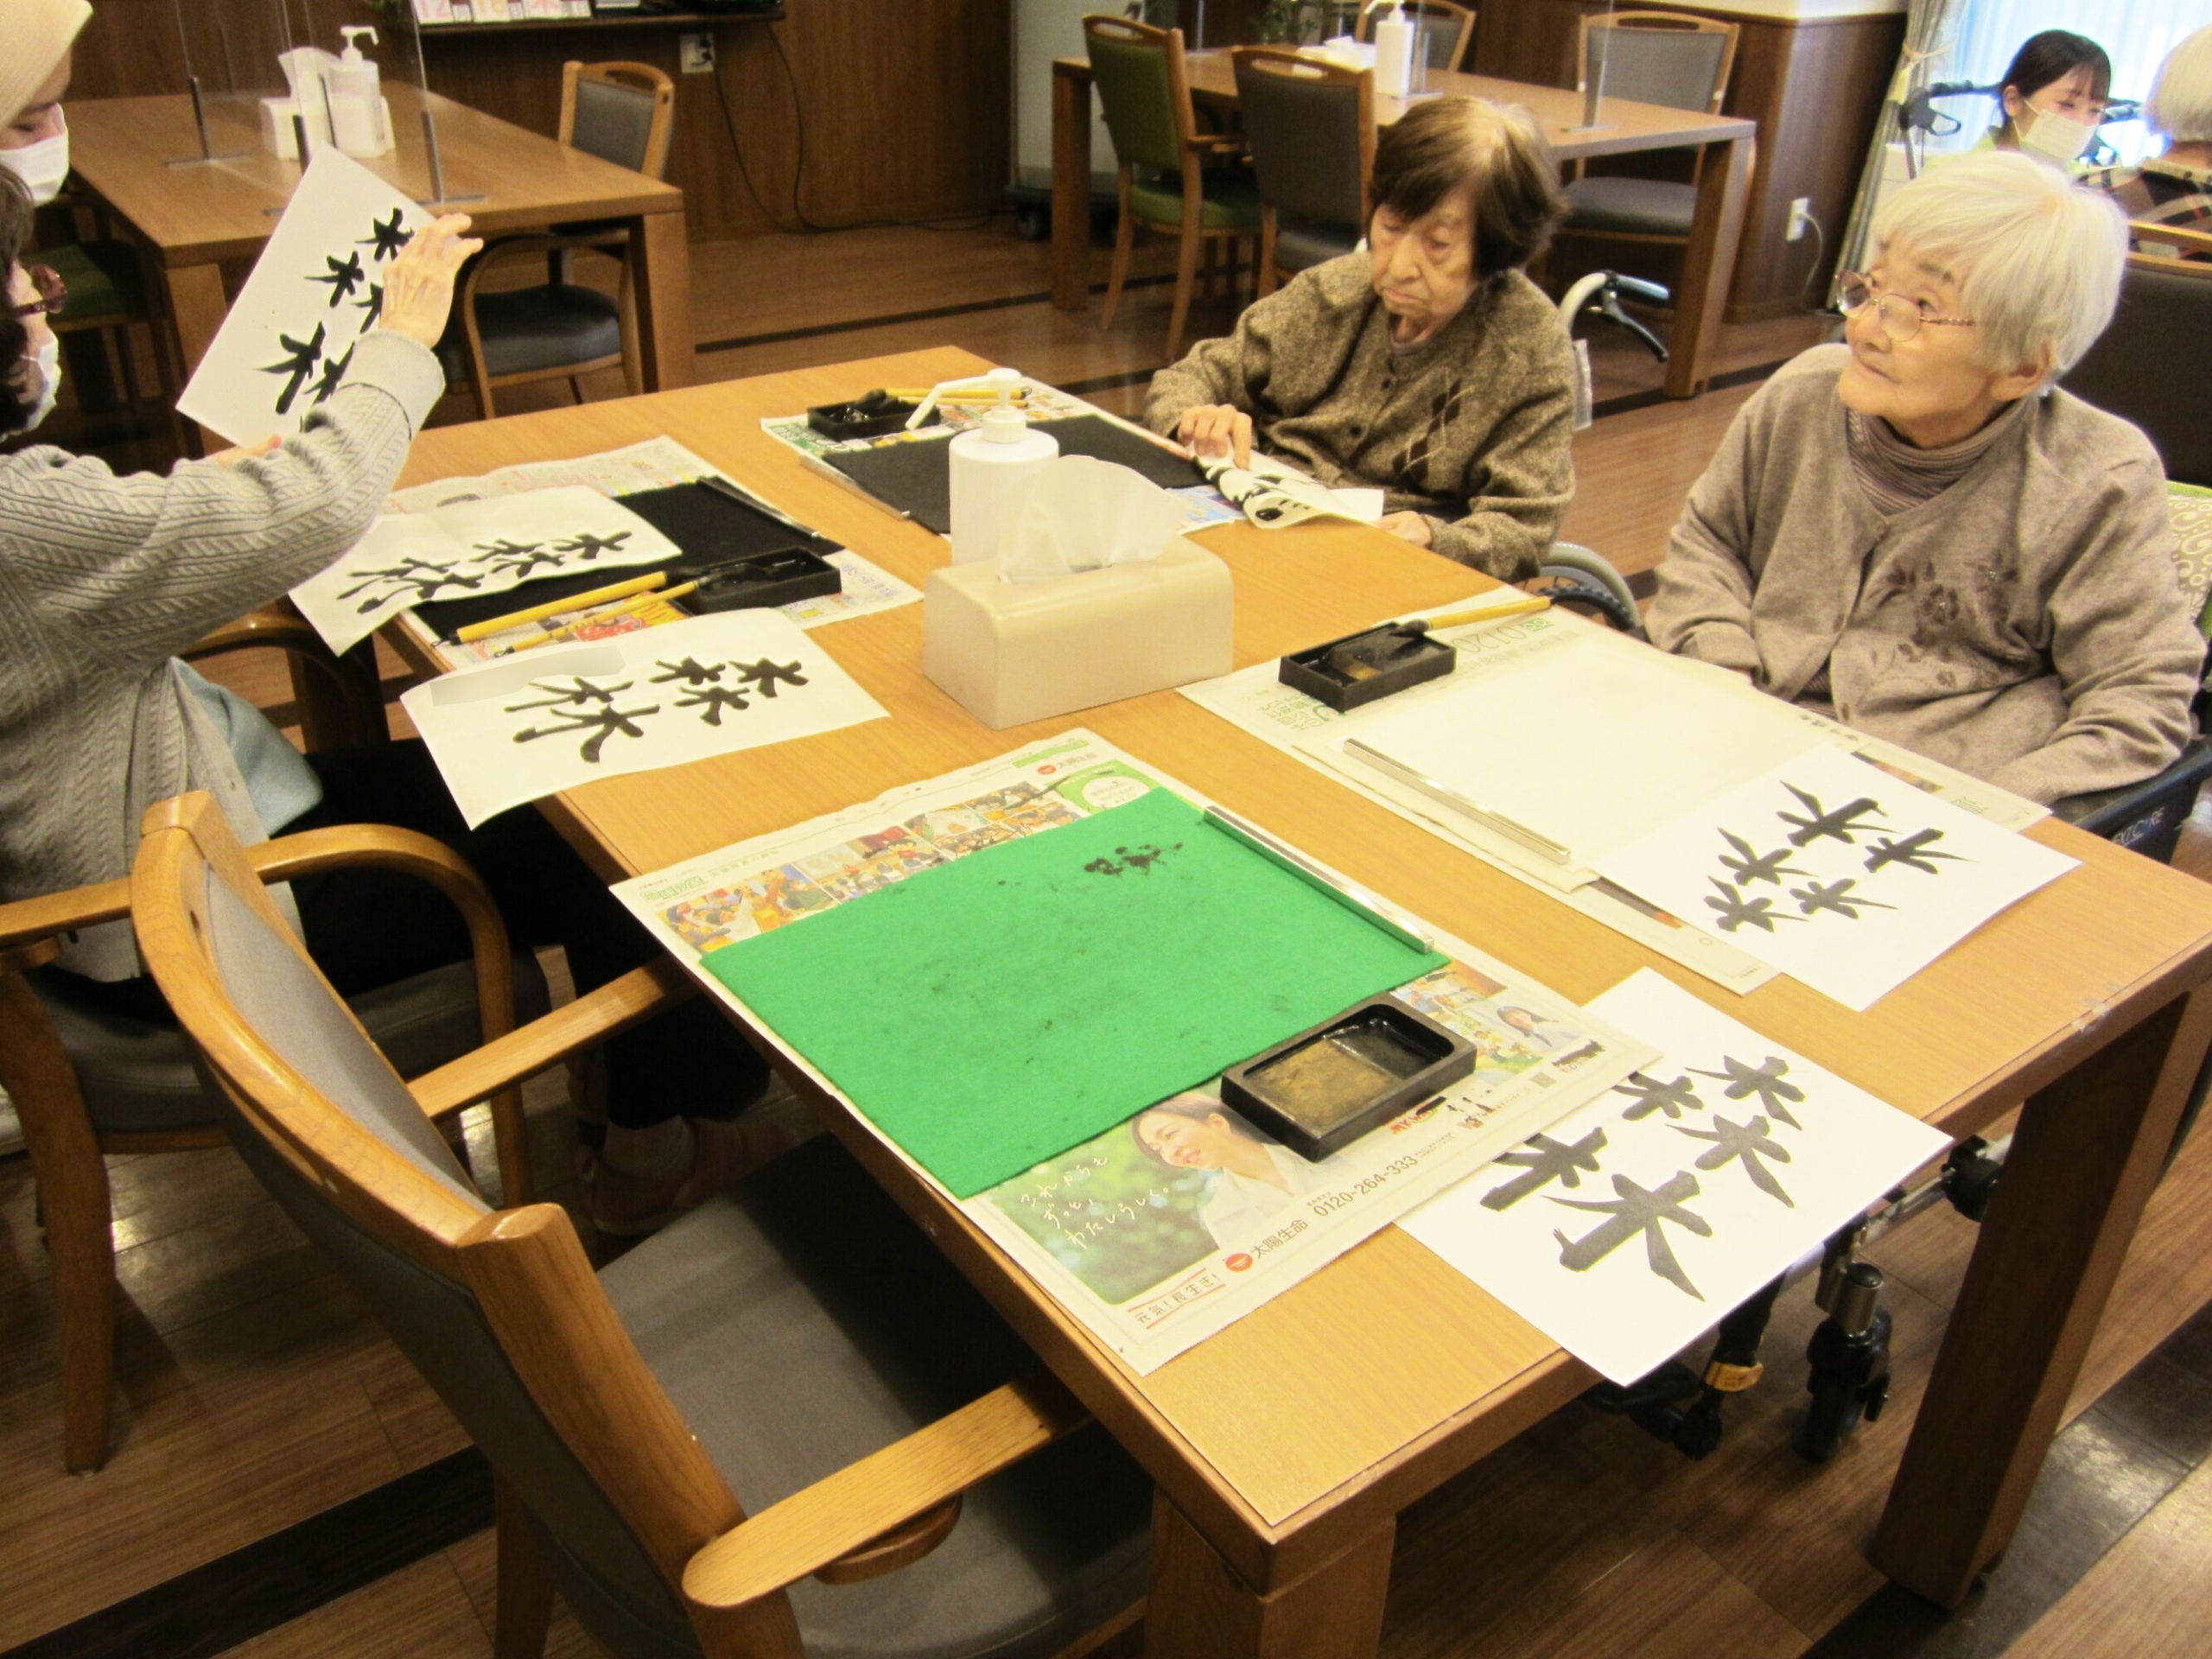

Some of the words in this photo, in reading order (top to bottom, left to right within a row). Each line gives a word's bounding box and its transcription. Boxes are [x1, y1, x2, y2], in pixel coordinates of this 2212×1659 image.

[1064, 1188, 1169, 1250] わたしらしく。
[1250, 1217, 1309, 1259] 太陽生命
[1313, 1154, 1419, 1217] 0120-264-333
